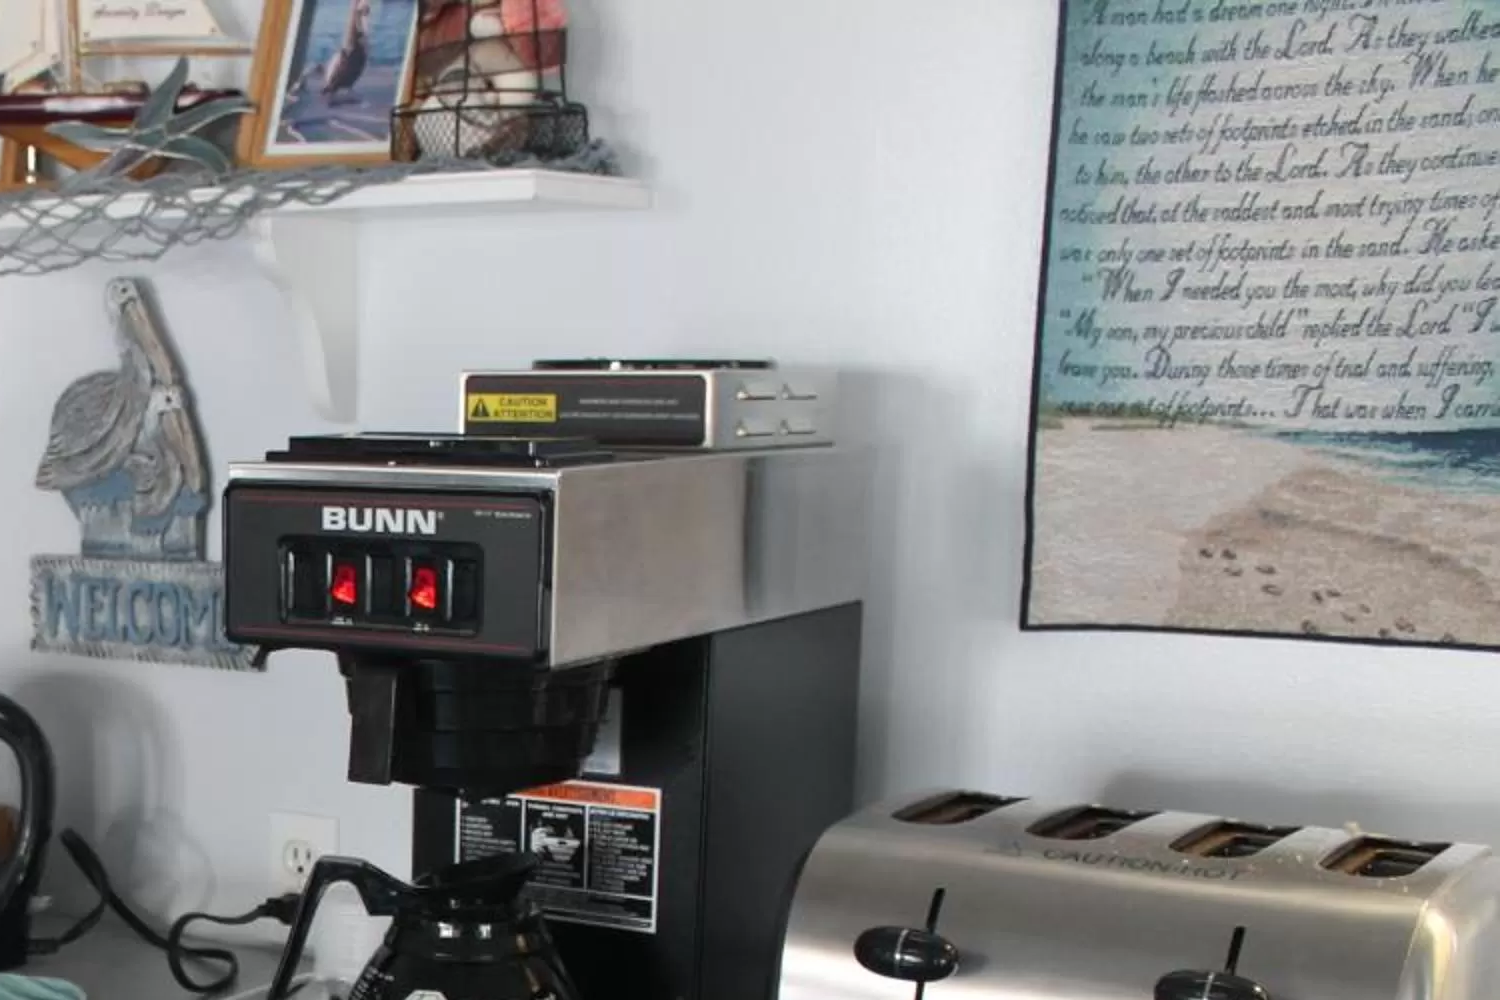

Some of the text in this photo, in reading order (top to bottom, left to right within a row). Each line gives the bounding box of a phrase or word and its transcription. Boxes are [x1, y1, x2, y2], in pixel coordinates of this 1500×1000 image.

[1208, 0, 1263, 22] dream
[1267, 2, 1298, 17] one
[1080, 35, 1126, 77] along
[1146, 35, 1198, 66] beach
[1201, 32, 1240, 62] with
[1244, 29, 1272, 61] the
[1387, 16, 1430, 60] they
[1080, 80, 1105, 107] the
[1261, 83, 1319, 101] across
[1324, 64, 1353, 97] the
[1403, 50, 1469, 91] When
[1067, 116, 1088, 145] he
[1130, 124, 1159, 146] two
[1210, 113, 1300, 155] footprints
[1386, 100, 1418, 133] the
[1075, 163, 1092, 185] to
[1135, 156, 1163, 186] the
[1164, 155, 1212, 185] other
[1214, 161, 1233, 184] to
[1234, 152, 1264, 184] the
[1377, 143, 1418, 184] they
[1160, 201, 1181, 222] at
[1182, 193, 1207, 222] the
[1213, 191, 1280, 222] saddest
[1281, 189, 1325, 221] and
[1324, 196, 1368, 218] most
[1430, 189, 1478, 212] times
[1097, 237, 1133, 269] only
[1135, 248, 1166, 263] one
[1168, 240, 1197, 263] set
[1197, 234, 1221, 272] of
[1209, 233, 1296, 272] footprints
[1301, 238, 1320, 260] in
[1324, 228, 1354, 260] the
[1182, 271, 1248, 301] needed
[1242, 285, 1277, 310] you
[1282, 270, 1310, 300] the
[1362, 268, 1399, 306] why
[1402, 264, 1446, 296] did
[1434, 278, 1472, 304] you
[1168, 324, 1244, 349] precious
[1365, 307, 1393, 338] the
[1143, 345, 1212, 386] During
[1217, 350, 1262, 379] those
[1265, 356, 1310, 379] times
[1312, 349, 1338, 387] of
[1334, 348, 1377, 379] trial
[1376, 345, 1419, 379] and
[1284, 384, 1342, 420] That
[1344, 405, 1377, 420] was
[1382, 390, 1428, 420] when
[1434, 384, 1461, 419] I
[322, 506, 437, 535] BUNN
[45, 571, 246, 653] WELCOM
